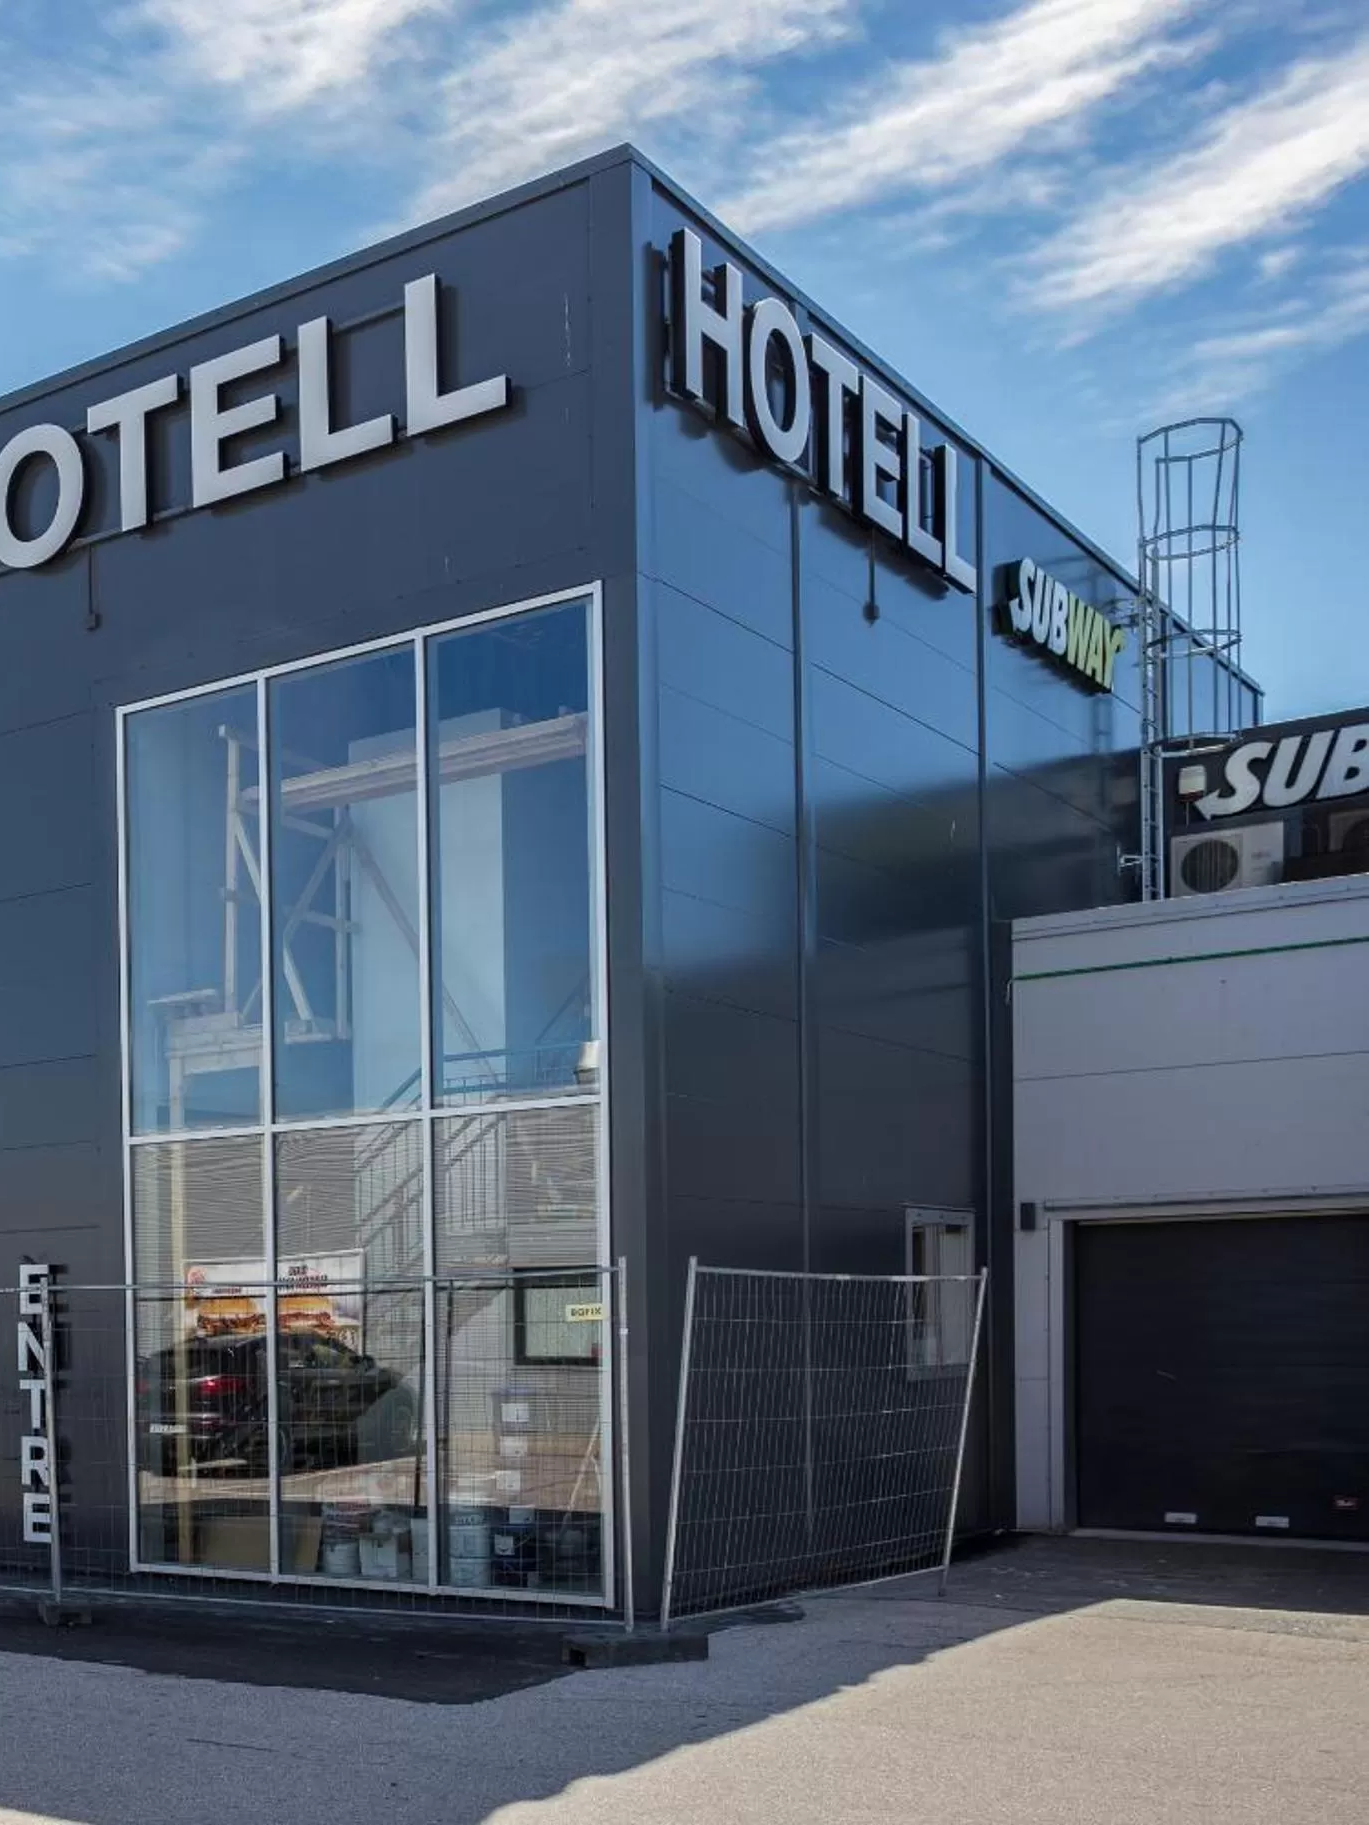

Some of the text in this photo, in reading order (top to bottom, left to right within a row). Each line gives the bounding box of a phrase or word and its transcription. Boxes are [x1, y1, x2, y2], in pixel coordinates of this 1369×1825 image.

[683, 226, 978, 597] HOTELL
[1009, 557, 1126, 689] SUBWAY
[17, 1264, 52, 1544] ENTRE
